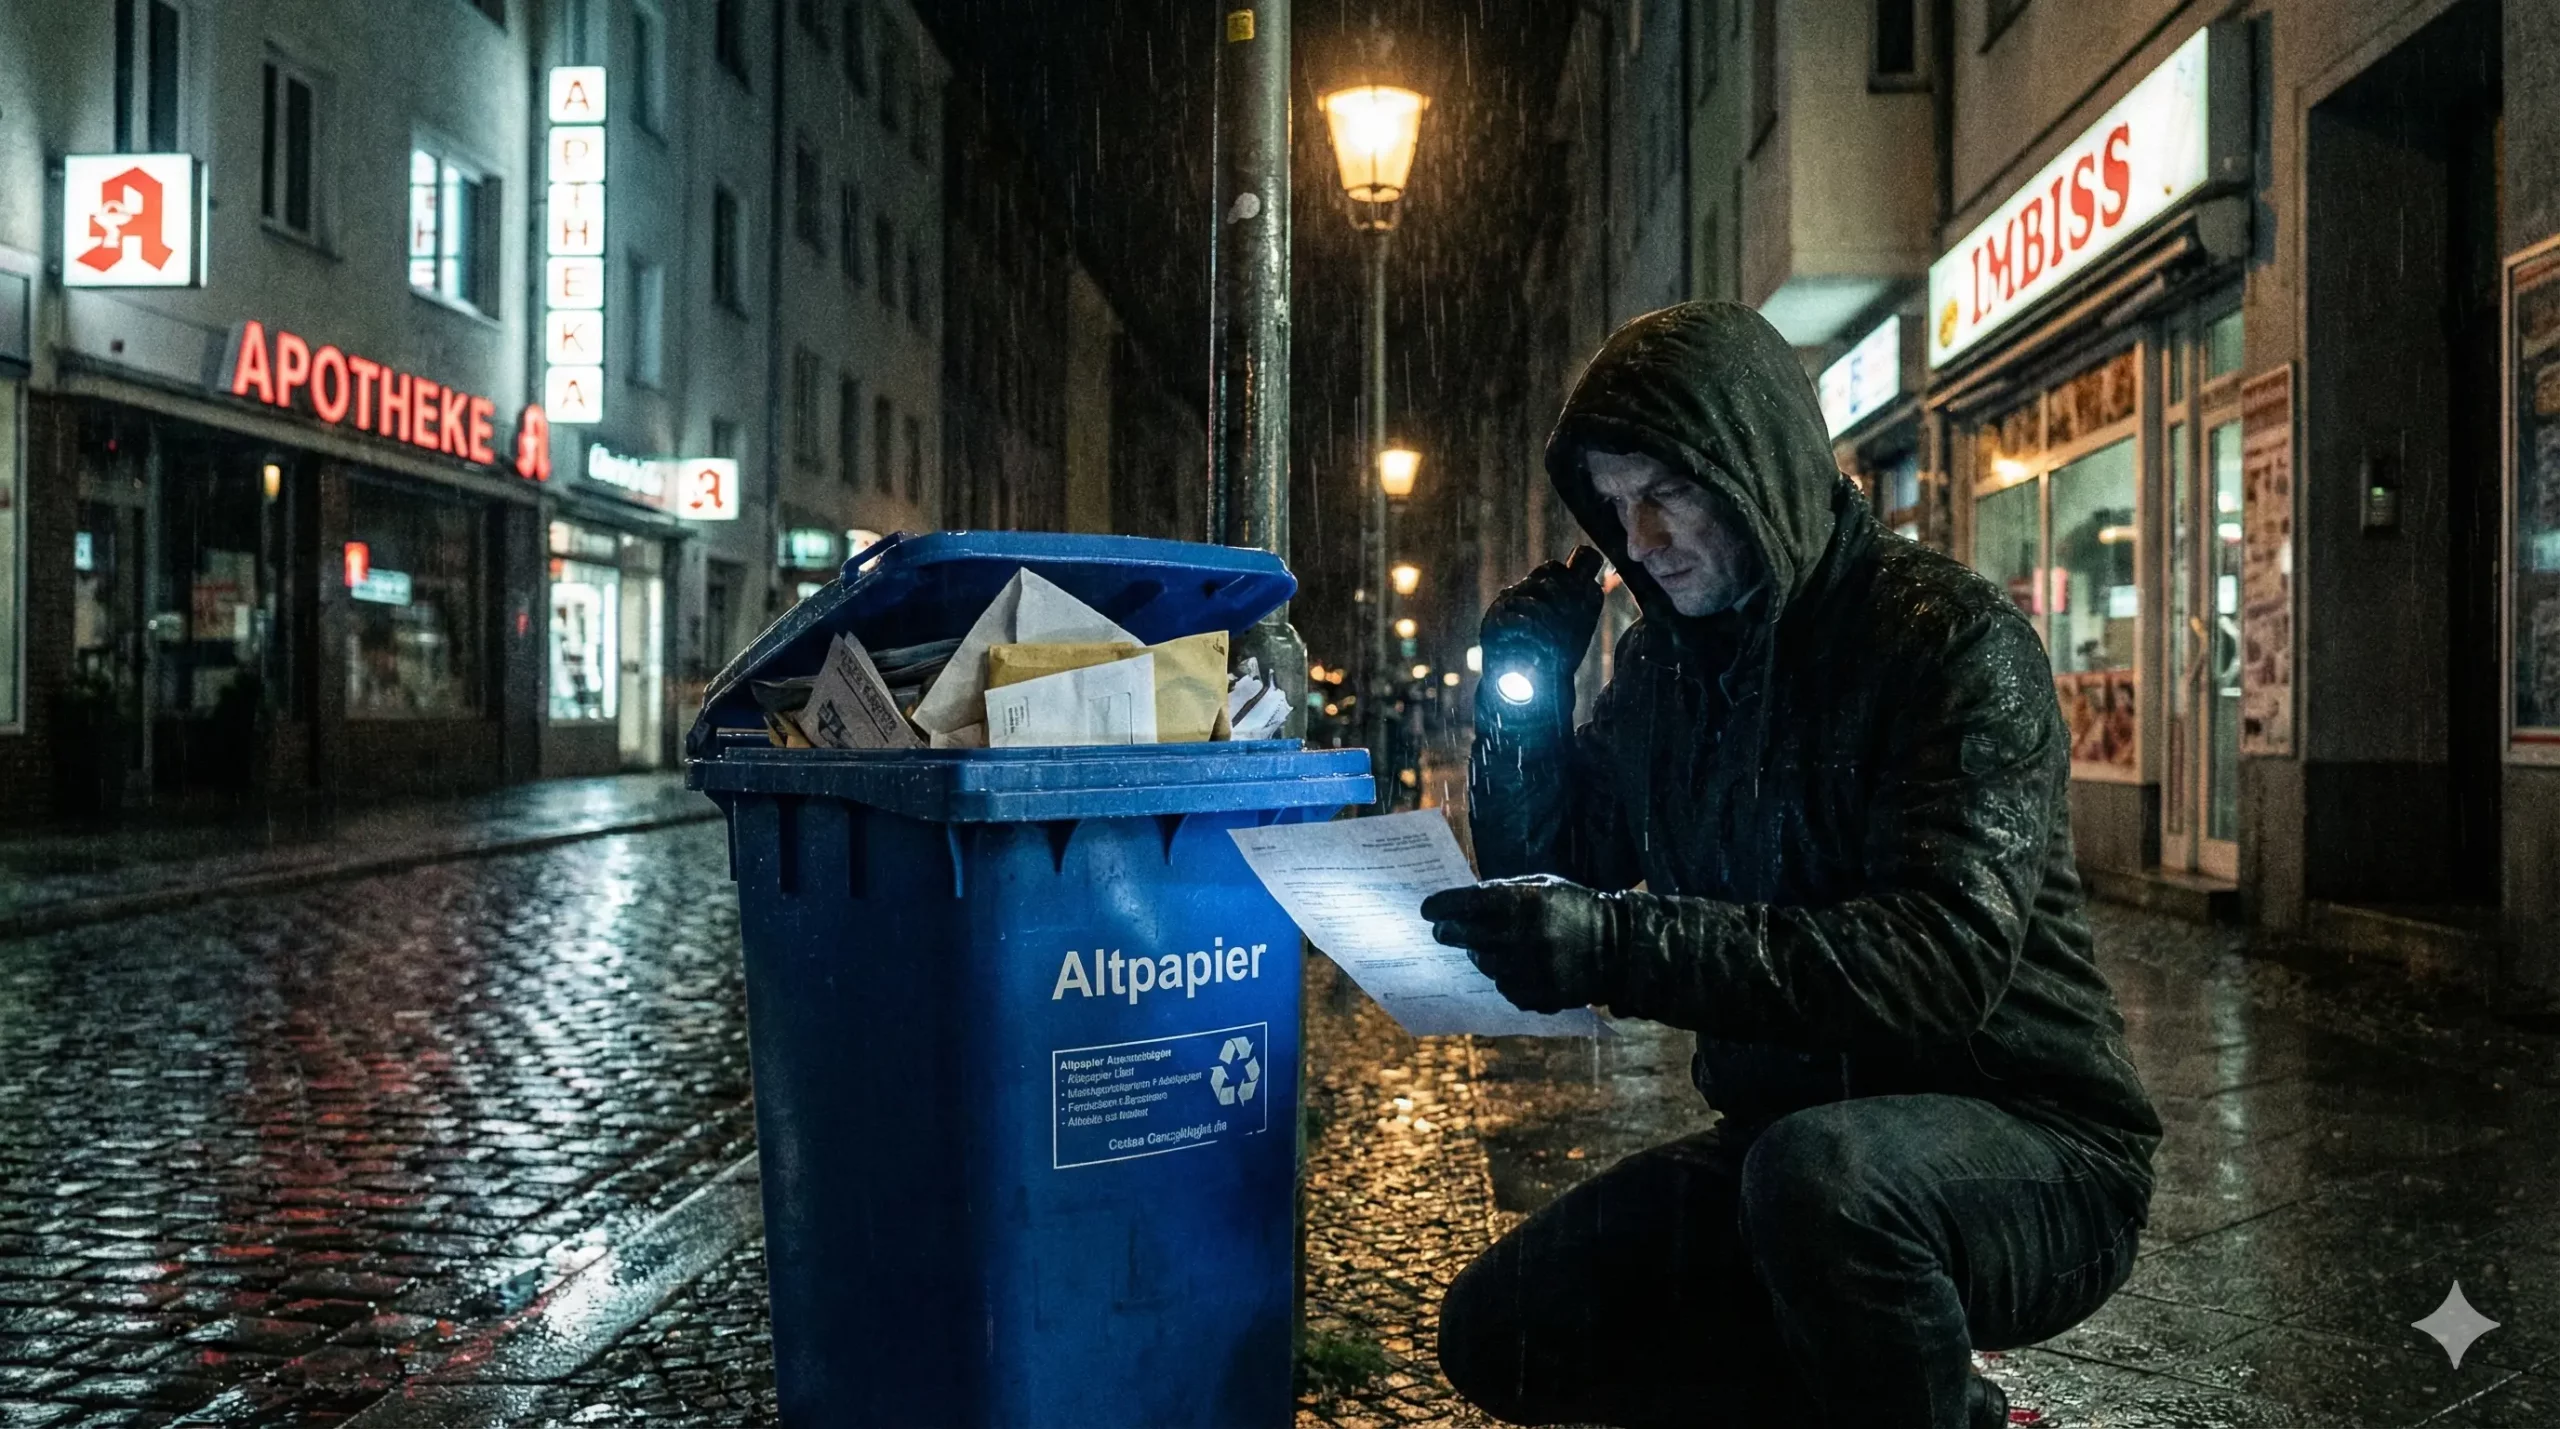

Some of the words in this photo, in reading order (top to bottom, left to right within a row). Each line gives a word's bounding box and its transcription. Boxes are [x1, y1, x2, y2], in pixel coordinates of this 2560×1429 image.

[1971, 121, 2130, 325] IMBISS
[232, 320, 496, 465] APOTHEKE
[1052, 936, 1267, 1005] Altpapier
